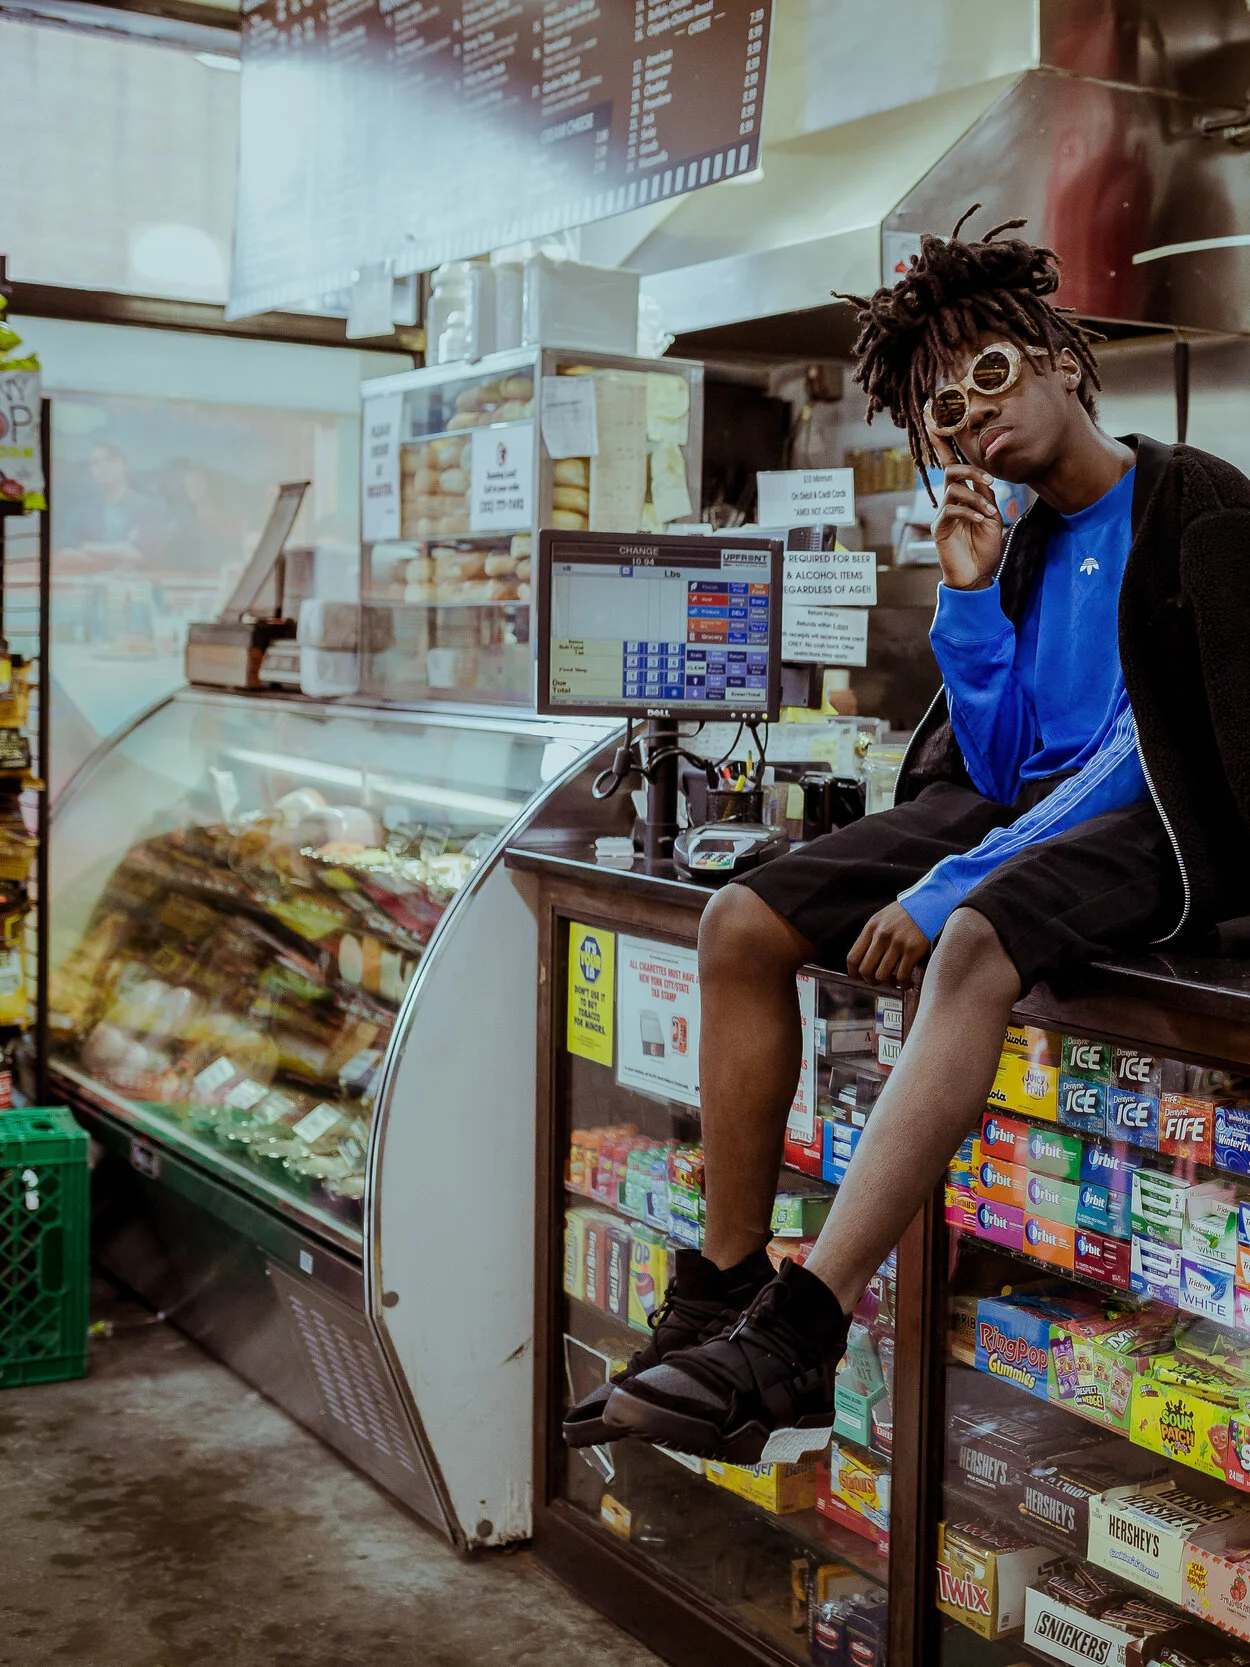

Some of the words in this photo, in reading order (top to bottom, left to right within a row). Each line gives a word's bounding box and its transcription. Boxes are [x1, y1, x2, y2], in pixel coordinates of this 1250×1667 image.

[619, 546, 659, 556] CHANGE
[723, 553, 768, 561] UPFRONT
[789, 554, 830, 563] REQUIRED
[833, 555, 849, 563] FOR
[852, 555, 871, 563] BEER
[786, 571, 792, 580] &
[796, 571, 837, 580] ALCOHOL
[840, 571, 863, 580] ITEMS
[784, 585, 832, 594] EGARDLESS
[835, 586, 846, 594] OF
[849, 585, 871, 594] AGE!!
[647, 709, 670, 717] DELL
[630, 960, 638, 969] ALL
[639, 962, 666, 976] CIGARETTES
[668, 968, 681, 979] MUST
[682, 971, 695, 983] HAVE
[574, 985, 589, 996] DON'T
[591, 989, 599, 1001] USE
[639, 973, 649, 984] NEW
[651, 976, 662, 987] YORK
[664, 979, 689, 994] CITY/STATE
[651, 987, 659, 998] TAX
[661, 990, 677, 1002] STAMP
[578, 1007, 600, 1022] TOBACCO
[588, 1000, 597, 1010] BUY
[1067, 1037, 1089, 1046] Dentyne
[1070, 1046, 1102, 1070] ICE
[1116, 1048, 1138, 1057] Dentyne
[1025, 1069, 1046, 1085] Juicy
[1119, 1057, 1152, 1083] ICE
[1026, 1082, 1046, 1098] Fruit
[1063, 1082, 1084, 1091] Dentyne
[1065, 1089, 1098, 1114] ICE
[1113, 1095, 1136, 1104] Dentyne
[1116, 1102, 1151, 1128] ICE
[1164, 1108, 1189, 1117] Dentyne
[984, 1120, 1015, 1145] Orbit
[1027, 1133, 1062, 1160] Orbit
[1088, 1149, 1119, 1171] Orbit
[980, 1162, 1012, 1188] Orbit
[1028, 1178, 1061, 1205] Orbit
[1080, 1187, 1106, 1208] Orbit
[977, 1203, 1008, 1229] Orbit
[1025, 1219, 1057, 1246] Orbit
[1076, 1236, 1101, 1256] Orbit
[1197, 1246, 1227, 1260] WHITE
[1188, 1276, 1211, 1291] Trident
[1183, 1292, 1227, 1317] WHITE
[988, 1353, 1036, 1390] Gummies
[1077, 1386, 1098, 1395] RESPECT
[1161, 1408, 1193, 1432] SOUR
[1161, 1424, 1195, 1447] PATCH
[959, 1445, 1008, 1486] HERSHEY'S
[1228, 1469, 1237, 1482] 24
[1025, 1486, 1076, 1531] HERSHEY'S
[1108, 1514, 1160, 1558] HERSHEY'S
[1037, 1612, 1108, 1663] SNICKERS
